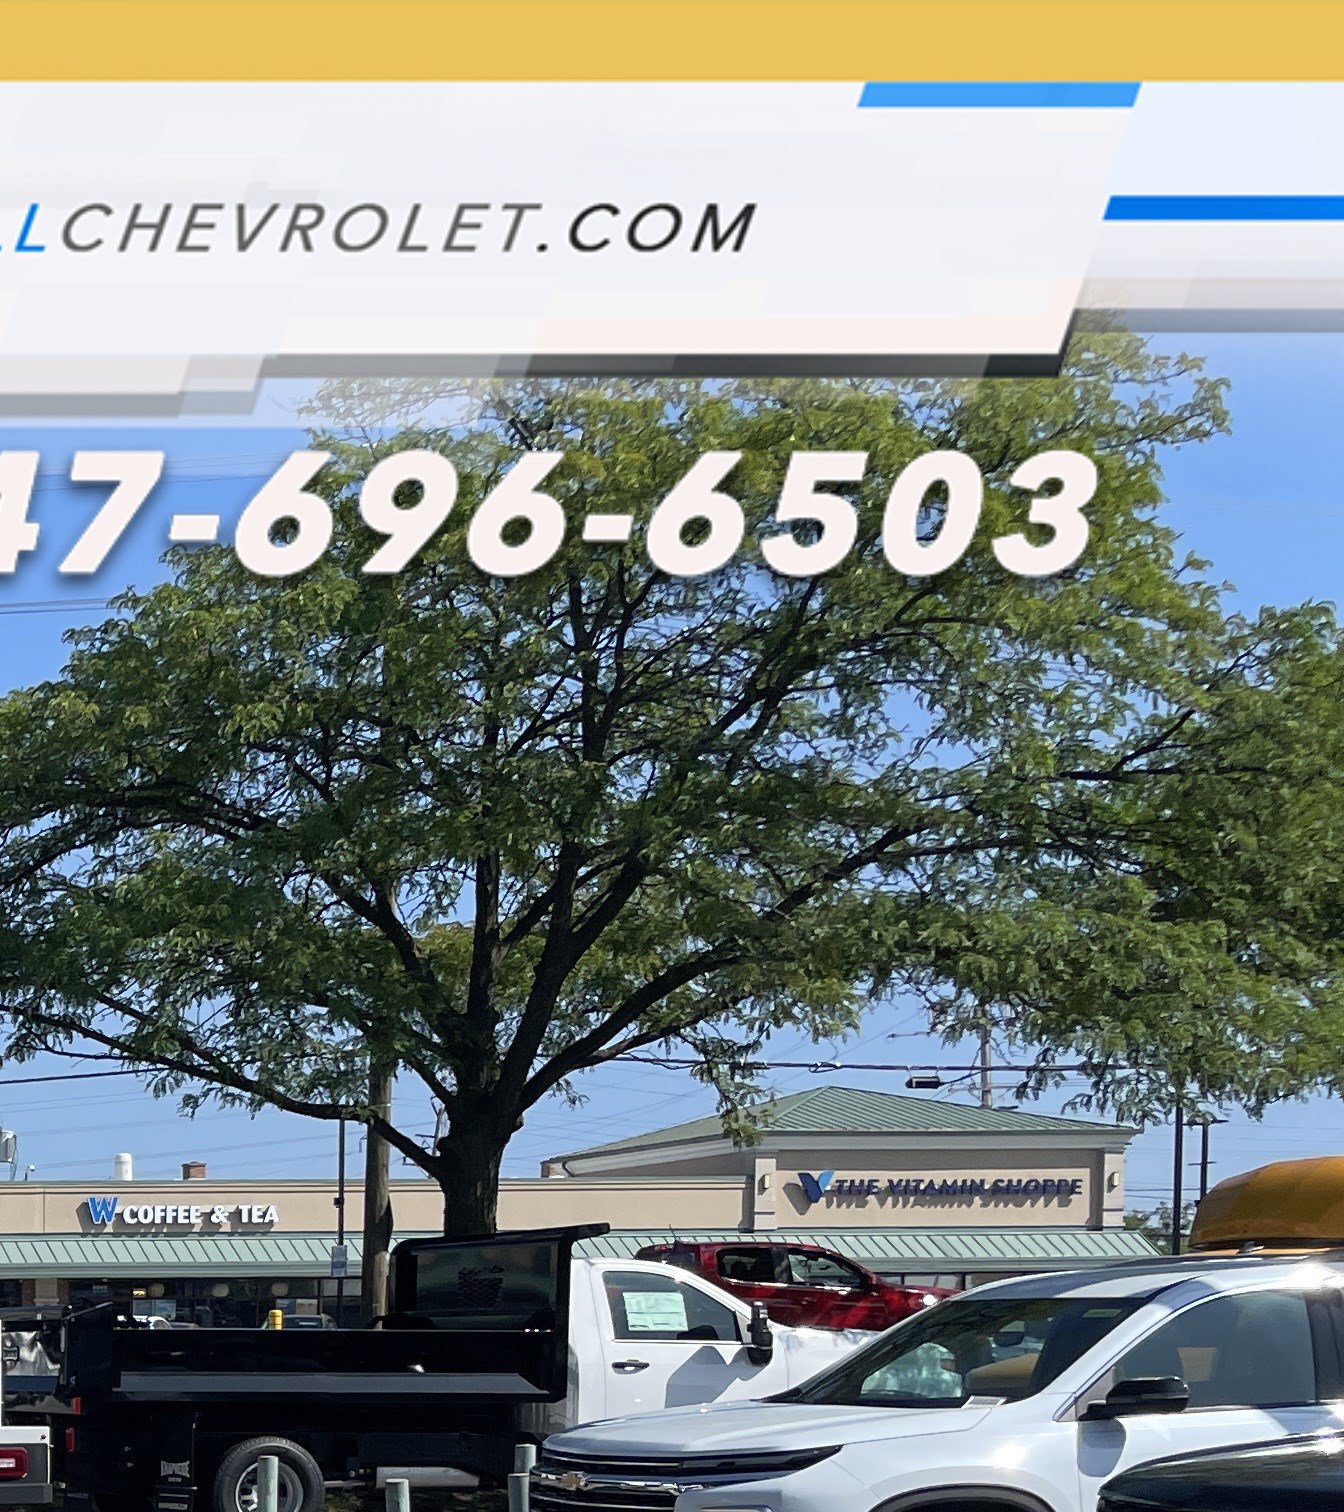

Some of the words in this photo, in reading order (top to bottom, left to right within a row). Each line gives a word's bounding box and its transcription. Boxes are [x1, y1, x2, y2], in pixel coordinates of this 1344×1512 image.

[835, 1179, 879, 1195] THE
[888, 1179, 986, 1195] VITAMIN
[991, 1178, 1084, 1195] SHOPPE
[123, 1205, 201, 1224] COFFEE
[211, 1205, 229, 1224] &
[239, 1205, 280, 1224] TEA
